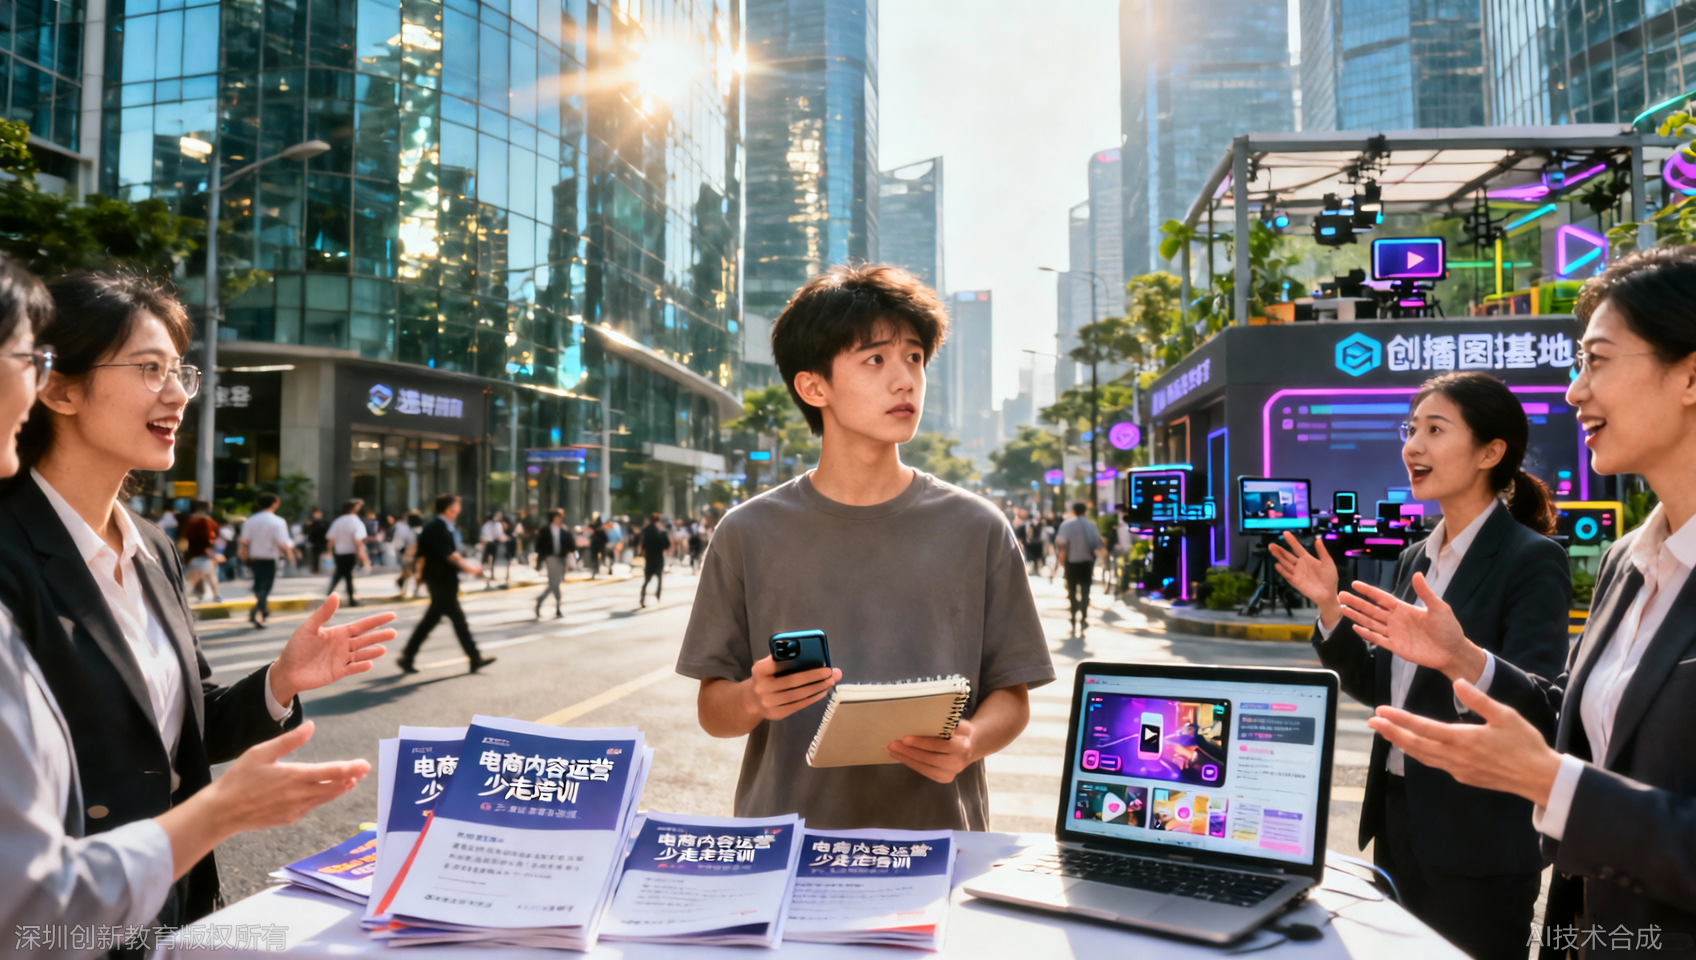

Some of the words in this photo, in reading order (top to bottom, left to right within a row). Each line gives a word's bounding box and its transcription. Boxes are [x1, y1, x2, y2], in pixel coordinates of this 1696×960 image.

[479, 750, 615, 782] 电商内容运营
